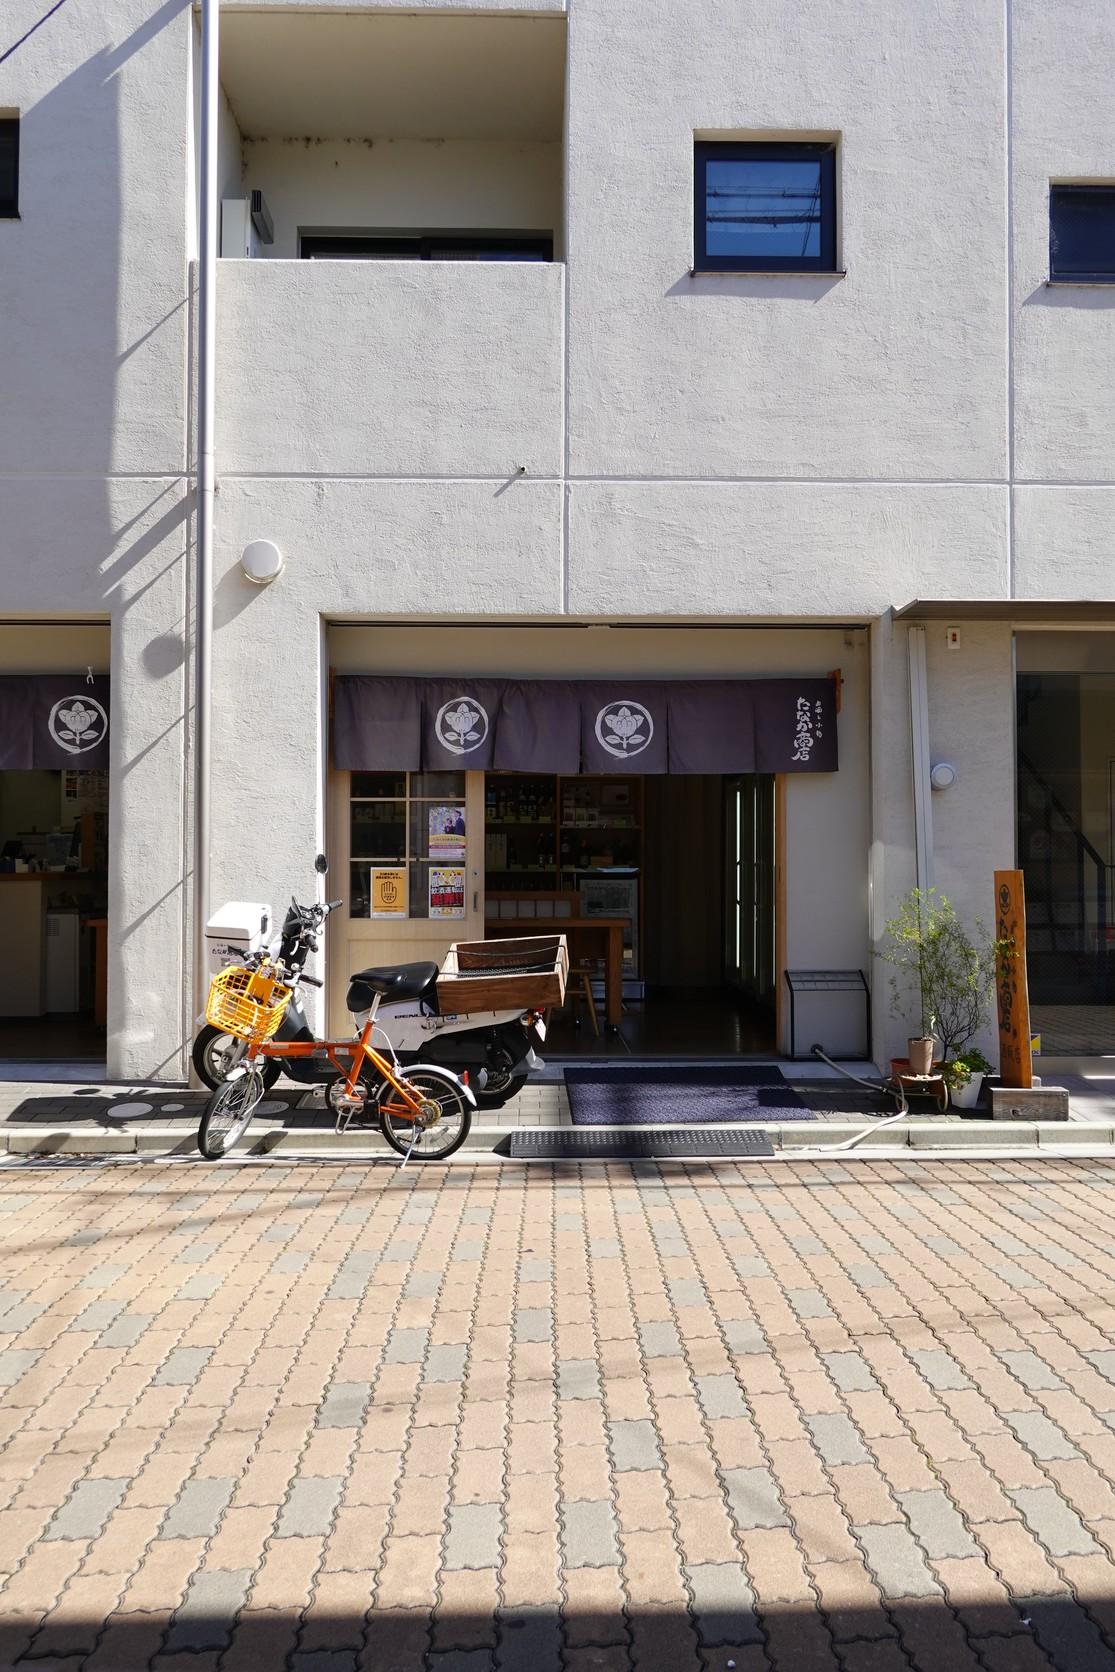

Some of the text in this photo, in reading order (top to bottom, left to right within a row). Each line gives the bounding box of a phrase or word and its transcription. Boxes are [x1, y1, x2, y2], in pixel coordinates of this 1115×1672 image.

[792, 697, 814, 761] たなか商店
